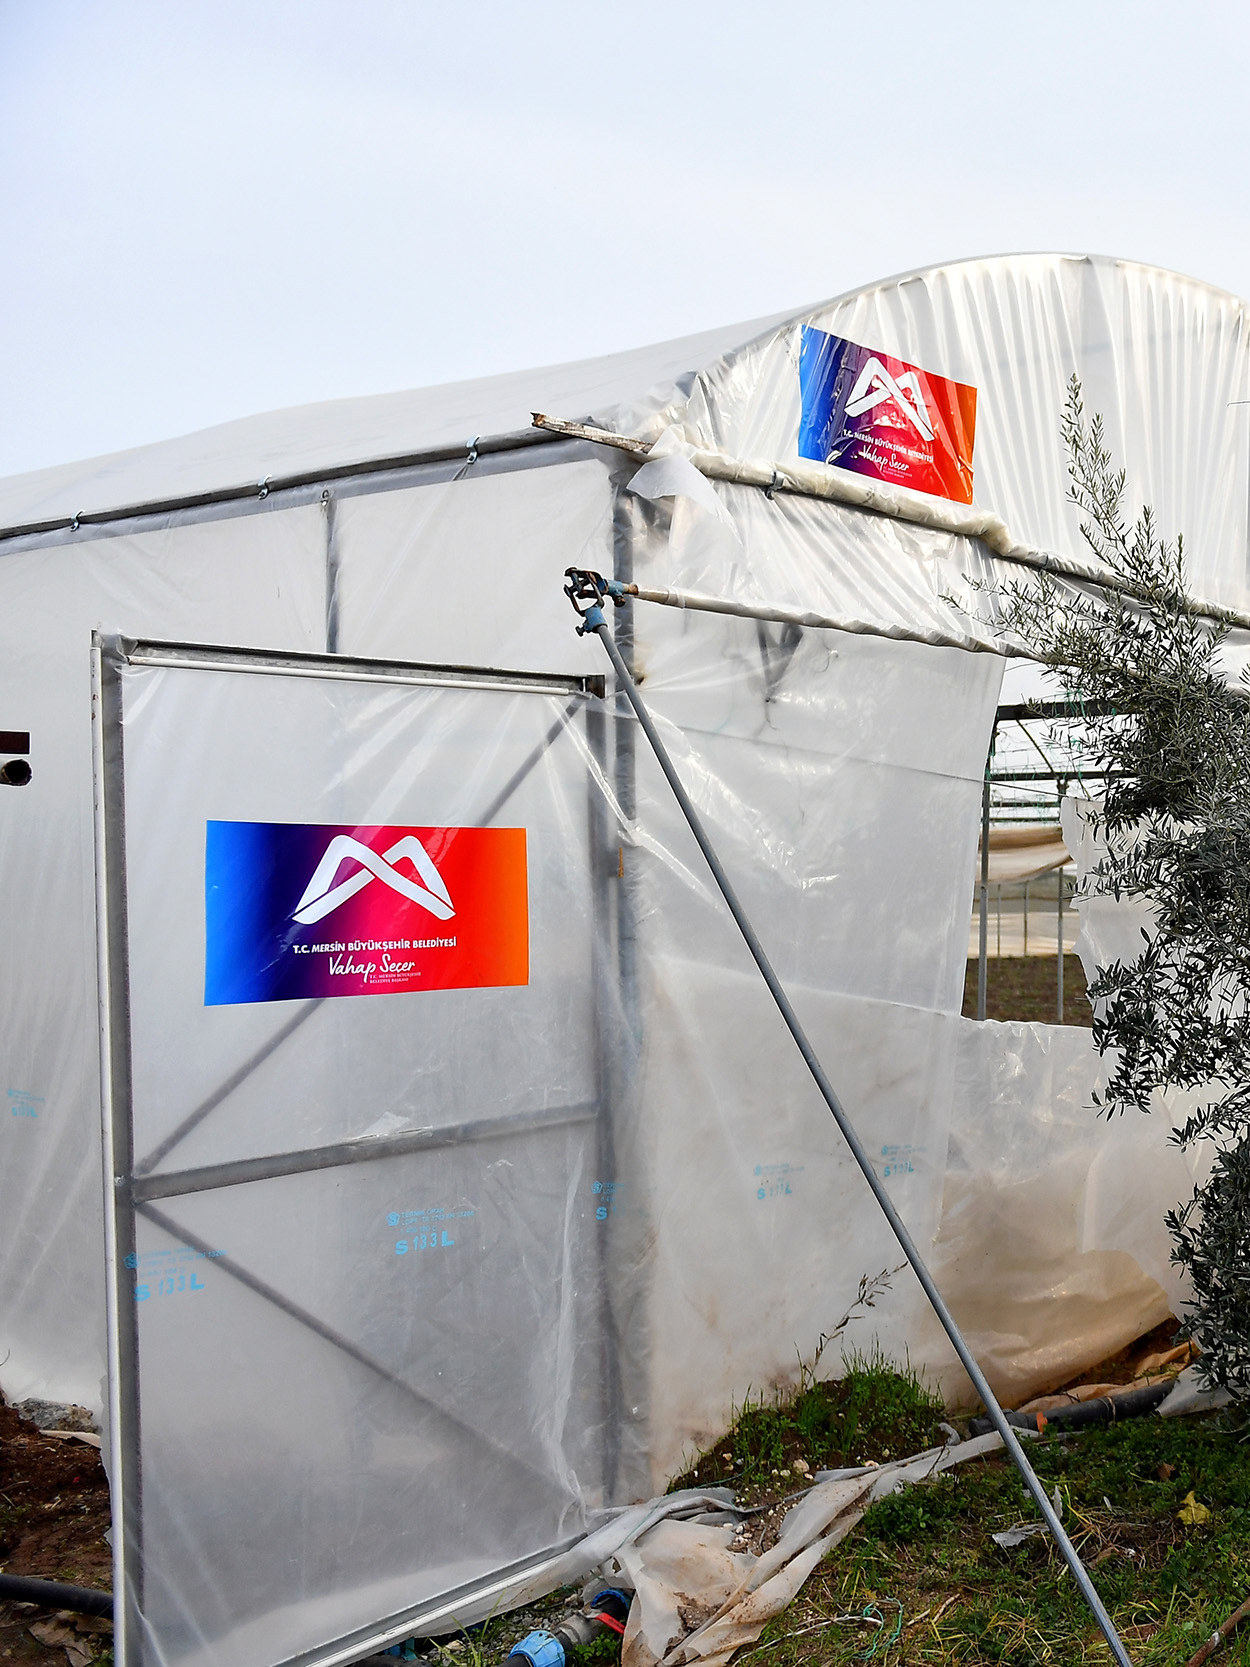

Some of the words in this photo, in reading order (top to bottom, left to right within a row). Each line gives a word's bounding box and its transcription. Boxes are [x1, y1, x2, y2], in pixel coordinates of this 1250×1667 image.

[862, 444, 889, 472] Vahap
[292, 944, 310, 954] T.C.
[311, 941, 346, 953] MERSİN
[348, 938, 411, 952] BÜYÜKŞEHİR
[412, 936, 457, 949] BELEDİYESİ
[329, 953, 377, 983] Vahap
[379, 953, 416, 973] Seçer
[596, 1207, 608, 1221] S
[395, 1239, 409, 1255] S
[413, 1232, 438, 1251] 133
[441, 1230, 455, 1247] L
[134, 1284, 151, 1302] S
[190, 1273, 205, 1291] L
